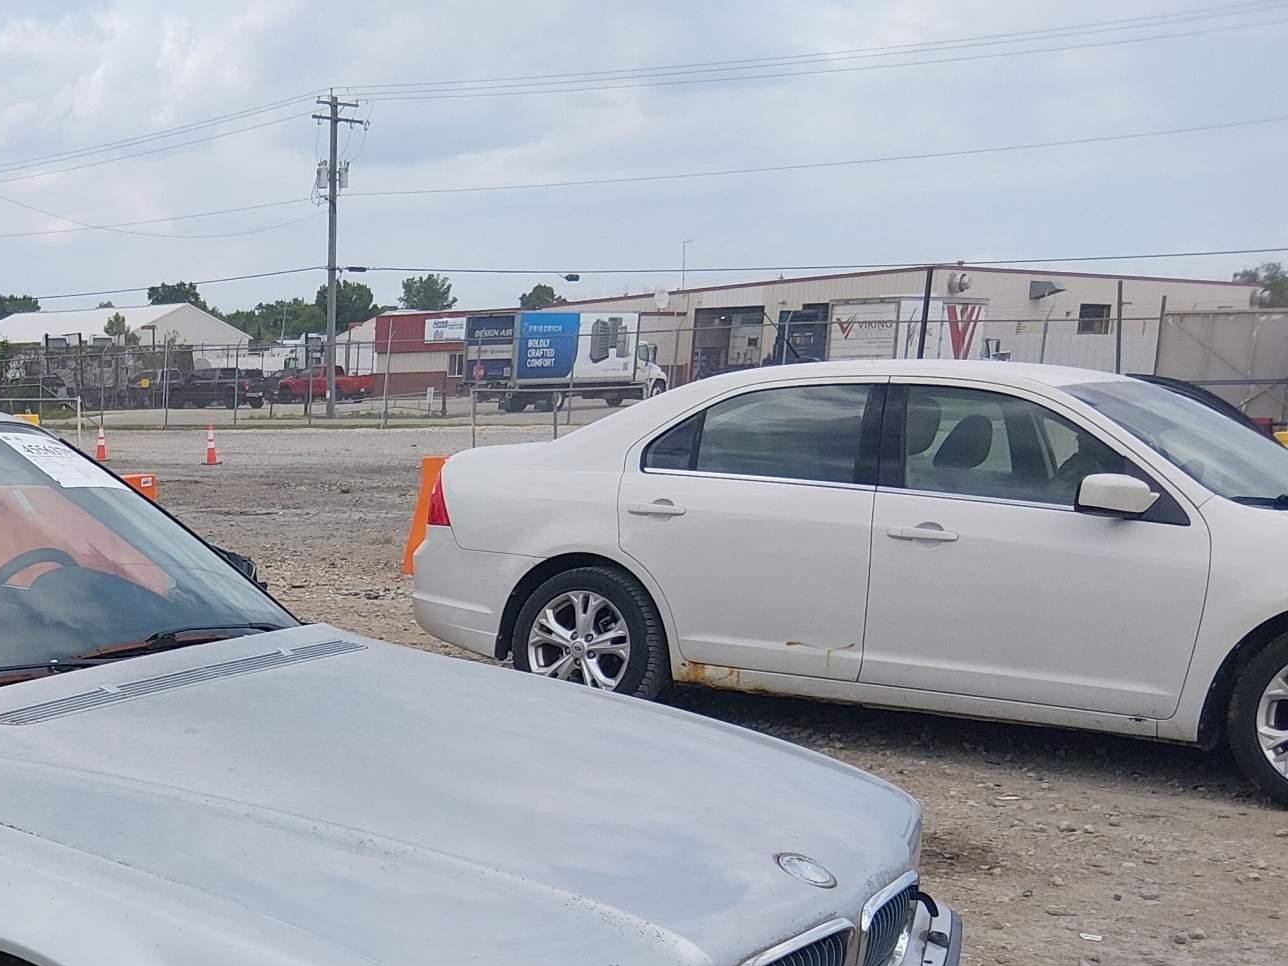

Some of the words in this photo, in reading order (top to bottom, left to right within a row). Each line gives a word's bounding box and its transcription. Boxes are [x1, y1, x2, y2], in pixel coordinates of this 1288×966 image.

[858, 319, 894, 329] VIKING
[499, 328, 513, 337] AIR
[527, 338, 551, 348] BOLDLY
[527, 348, 555, 358] CRAFTED
[526, 358, 555, 368] COMFORT
